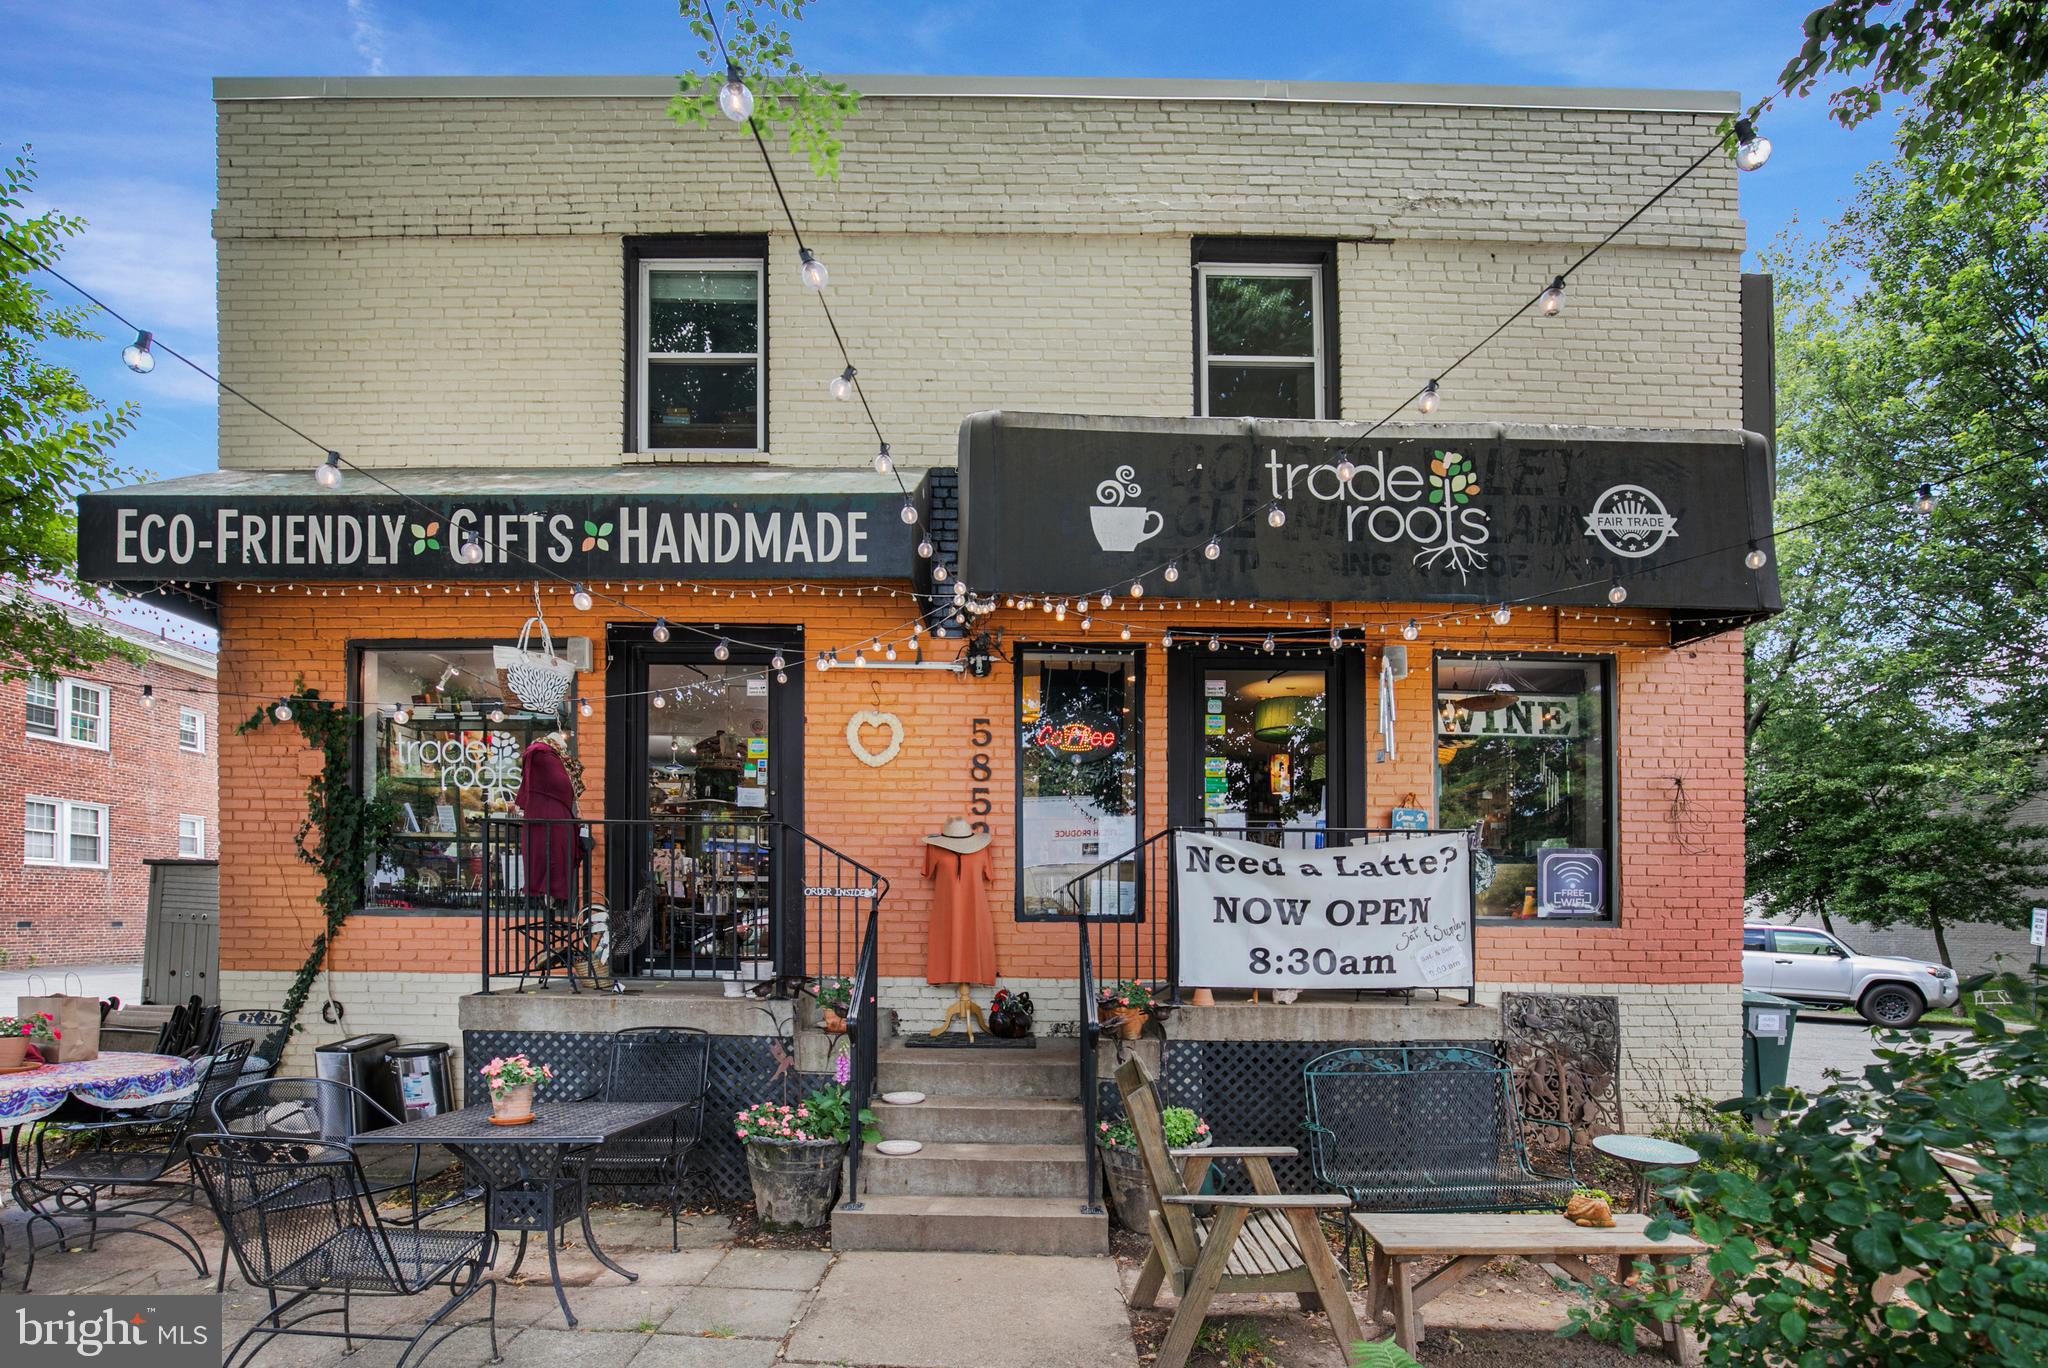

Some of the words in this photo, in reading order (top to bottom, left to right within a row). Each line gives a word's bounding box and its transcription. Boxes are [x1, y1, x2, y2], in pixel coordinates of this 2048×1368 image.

[1264, 448, 1424, 502] trade
[116, 508, 406, 565] ECO-FRIENDLY
[450, 508, 575, 565] GIFTS
[619, 506, 868, 564] HANDMADE
[1346, 498, 1490, 547] roots
[1597, 517, 1623, 527] FAIR
[1627, 517, 1665, 527] TRADE
[1438, 698, 1572, 735] WINE
[395, 730, 487, 765] trade
[1037, 725, 1116, 747] Coffee
[441, 762, 523, 790] roots
[1185, 845, 1286, 877] Need
[1300, 863, 1323, 877] a
[1333, 846, 1458, 877] Latte?
[804, 887, 832, 896] ORDER
[1561, 889, 1585, 897] FREE
[1561, 898, 1585, 907] WIFI
[1213, 896, 1311, 926] NOW
[1325, 896, 1432, 927] OPEN
[1249, 947, 1397, 976] 8:30am
